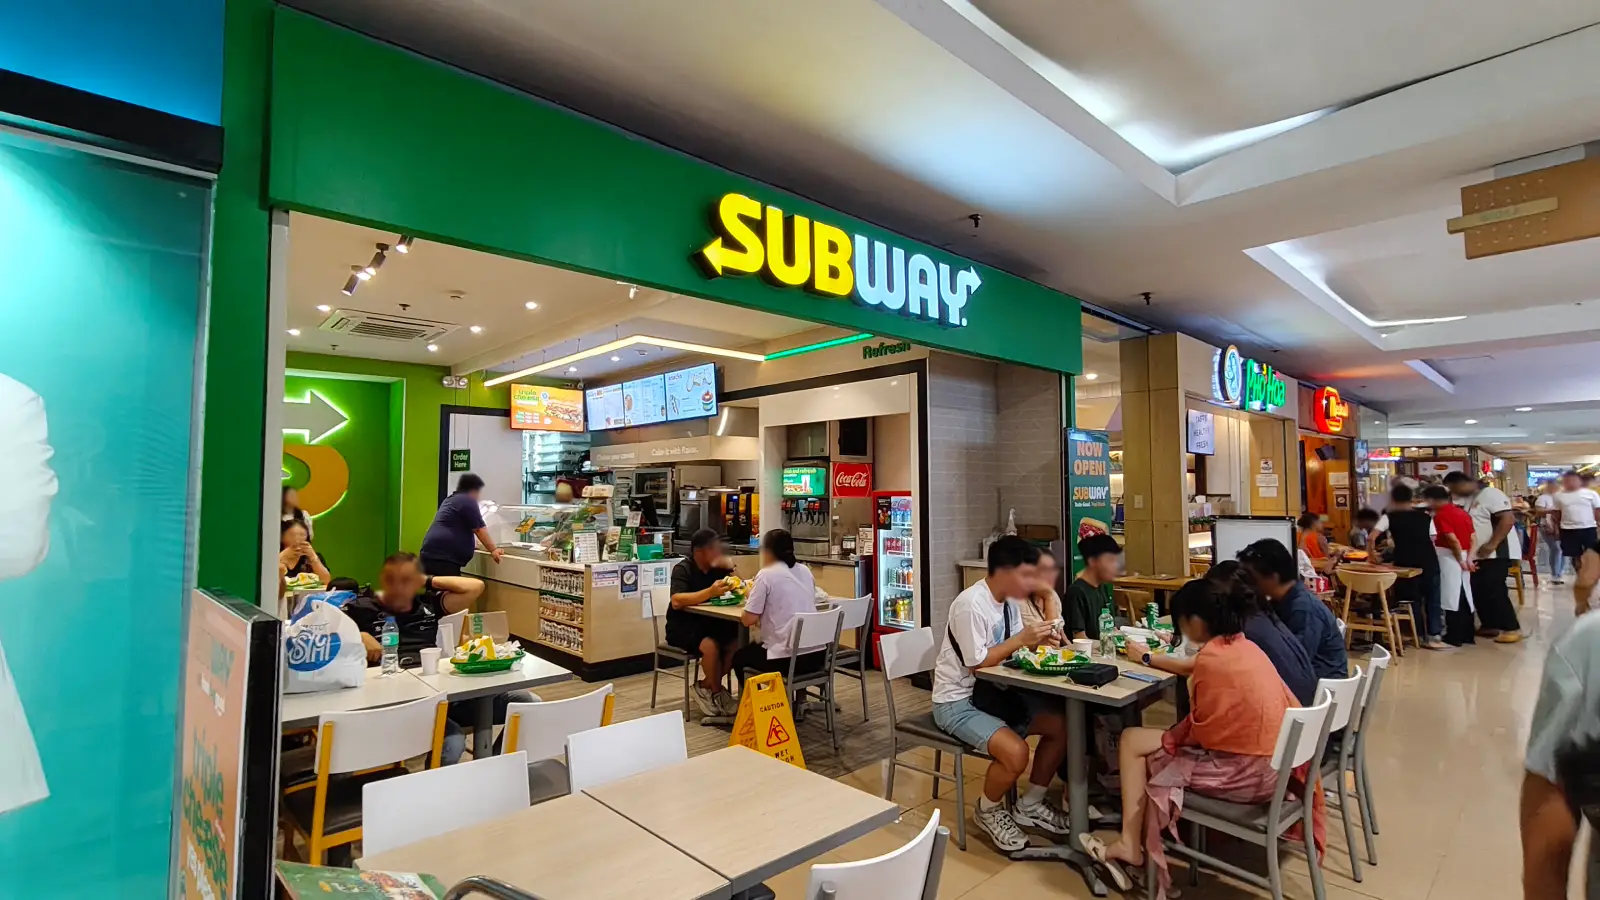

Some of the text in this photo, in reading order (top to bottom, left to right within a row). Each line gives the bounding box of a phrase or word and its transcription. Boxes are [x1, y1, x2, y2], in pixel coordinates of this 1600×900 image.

[703, 193, 982, 326] SUBWAY
[863, 342, 911, 359] Refresh
[452, 452, 469, 460] Order
[1076, 441, 1103, 457] NOW
[1073, 459, 1106, 476] OPEN!
[1072, 486, 1109, 500] SUBWAY
[759, 701, 785, 713] CAUTION
[774, 748, 789, 759] WET
